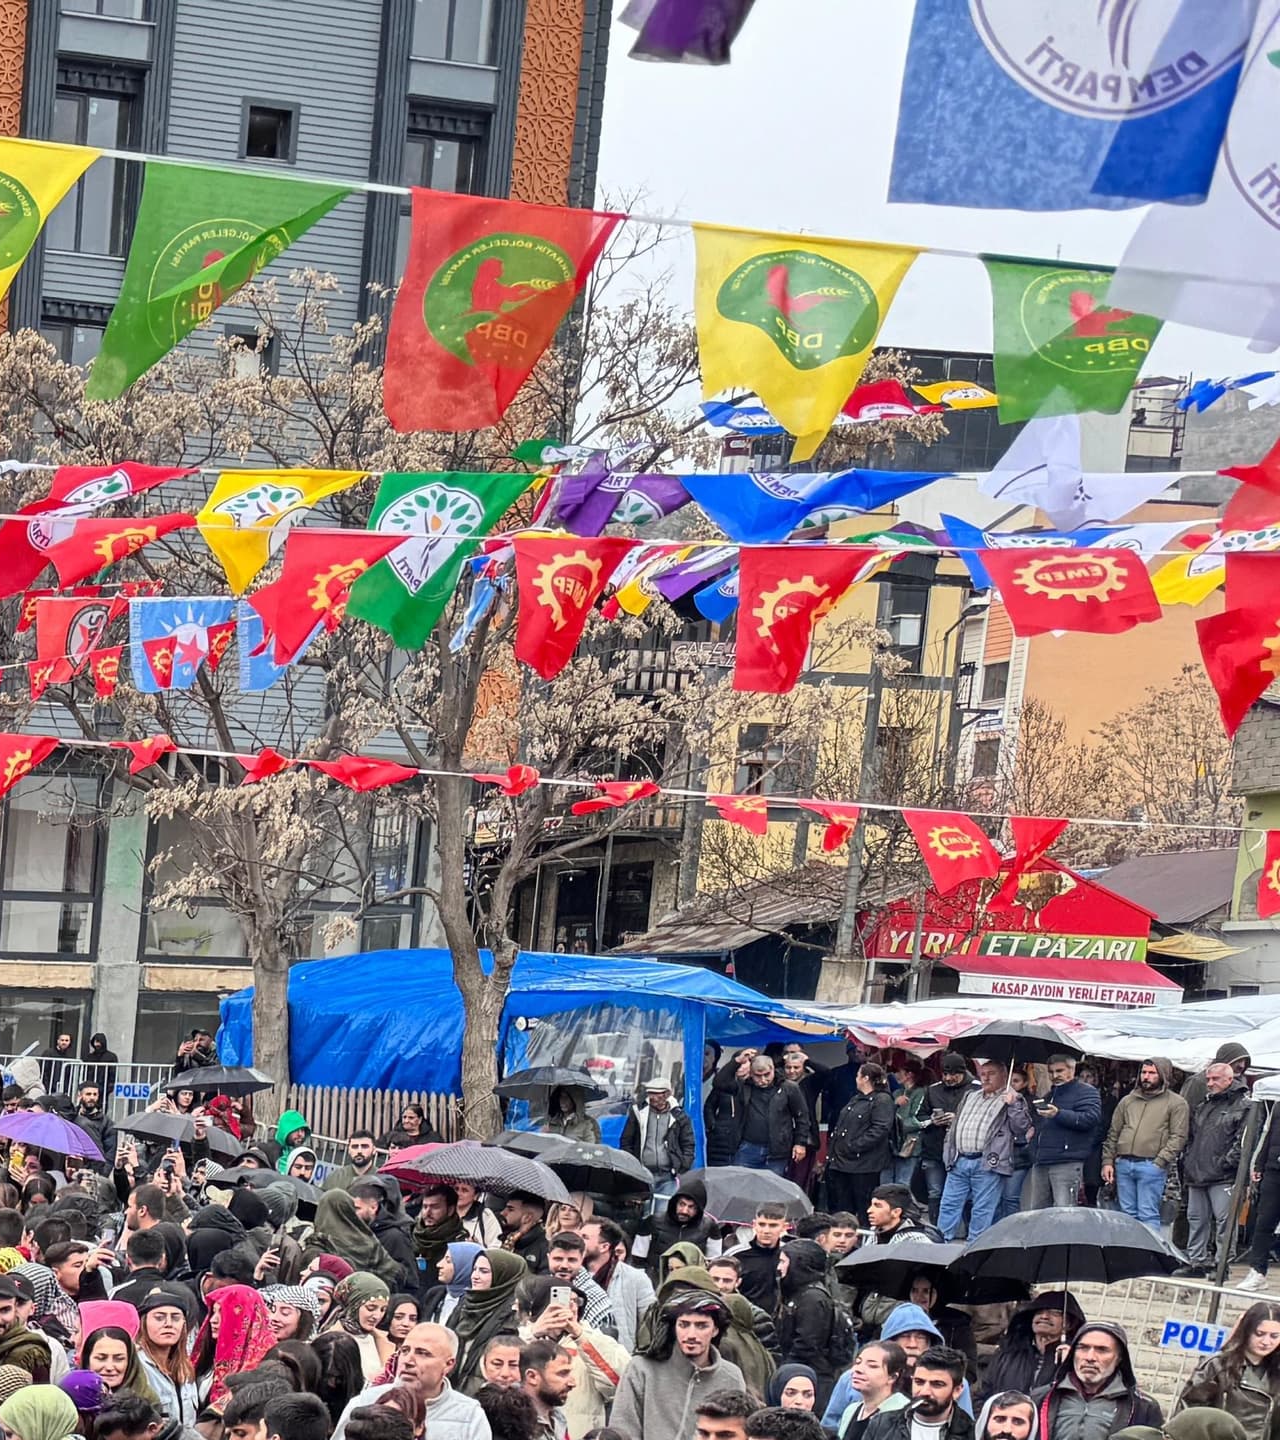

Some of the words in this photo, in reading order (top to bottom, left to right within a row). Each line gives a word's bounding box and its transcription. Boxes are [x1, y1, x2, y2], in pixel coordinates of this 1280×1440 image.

[31, 518, 53, 548] ARTİ
[986, 935, 1026, 958] ET
[1031, 936, 1138, 961] PAZARI
[991, 981, 1028, 997] KASAP
[1030, 983, 1064, 999] AYDIN
[1068, 985, 1099, 1001] YERLİ
[1100, 989, 1113, 1002] ET
[1115, 990, 1156, 1005] PAZARI
[115, 1084, 150, 1098] POLİS
[1161, 1320, 1225, 1354] POLİ
